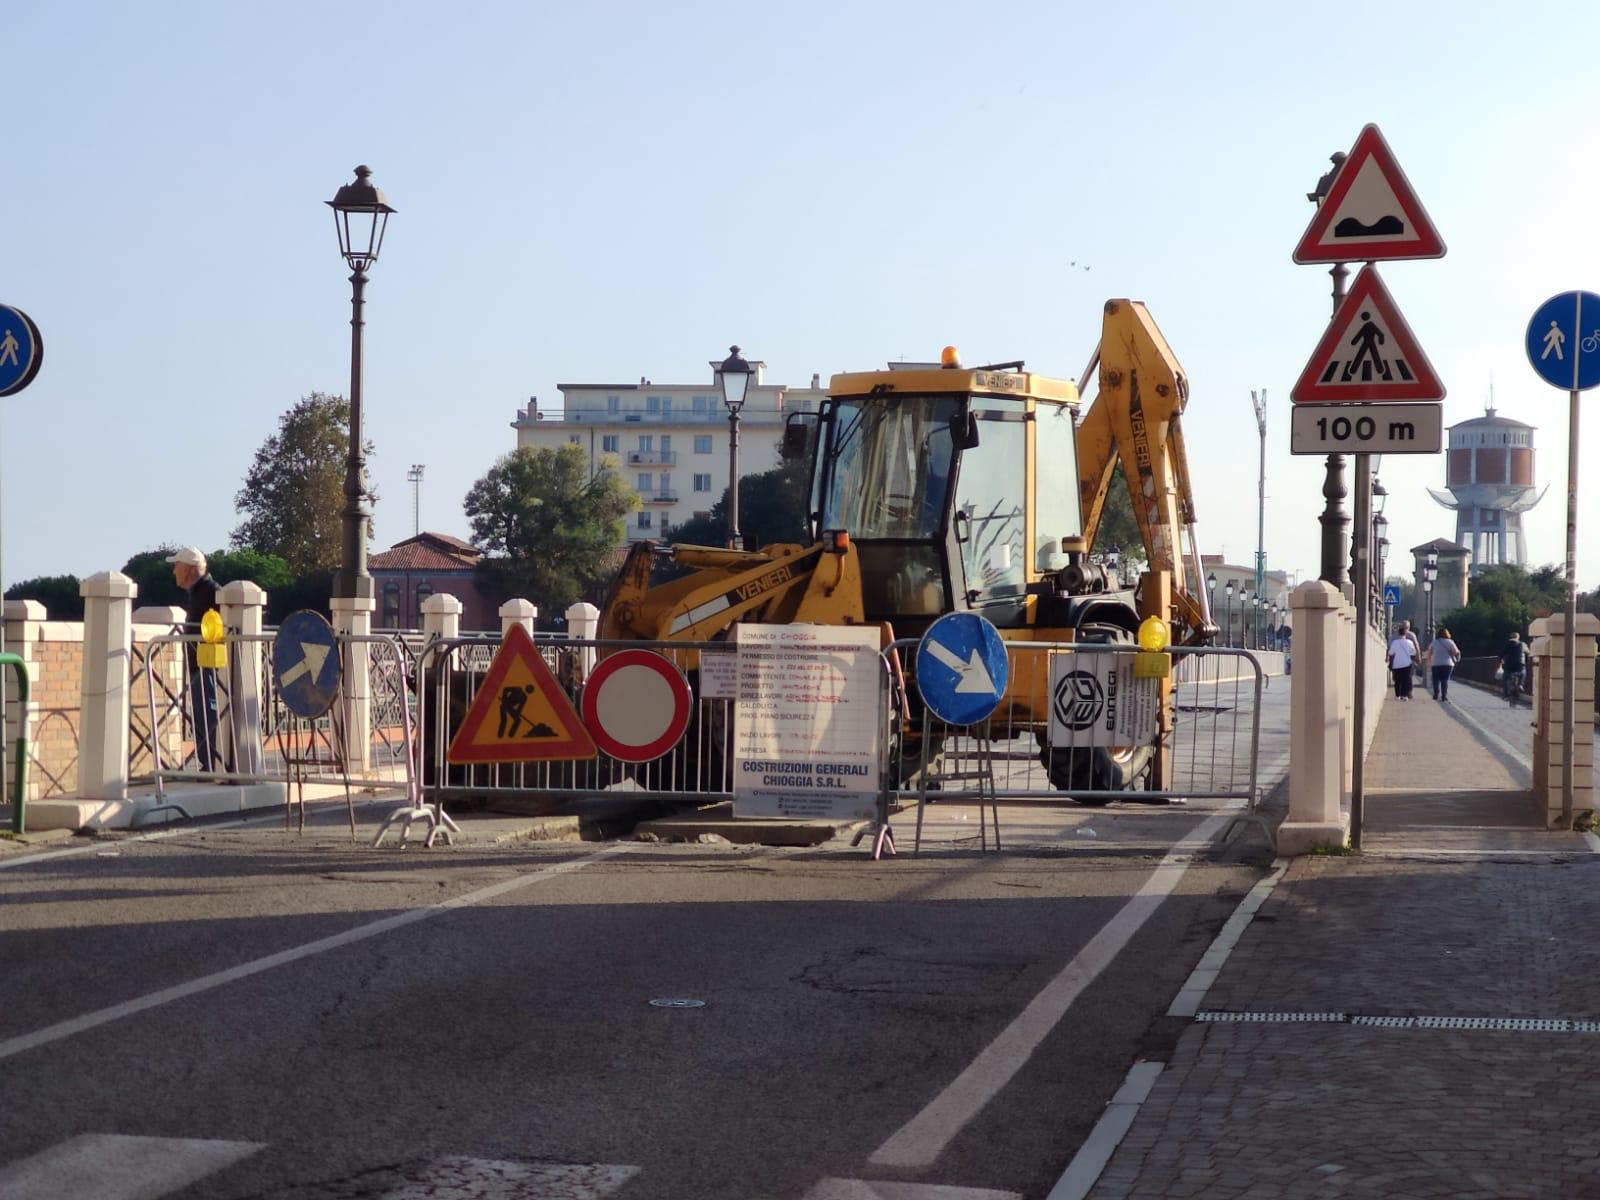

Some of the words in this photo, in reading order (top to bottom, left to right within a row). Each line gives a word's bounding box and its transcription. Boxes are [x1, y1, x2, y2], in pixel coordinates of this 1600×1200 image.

[984, 374, 1016, 389] VENIERI
[1316, 416, 1376, 441] 100
[1388, 421, 1415, 441] m
[1130, 409, 1151, 467] VENIERI
[735, 565, 792, 601] VENIERI
[742, 632, 768, 640] COMUNE
[740, 673, 786, 681] COMMITTENTE
[742, 761, 813, 775] COSTRUZIONI
[815, 763, 869, 776] GENERALI
[763, 775, 813, 787] CHIOGGIA
[816, 777, 847, 789] S.R.L.
